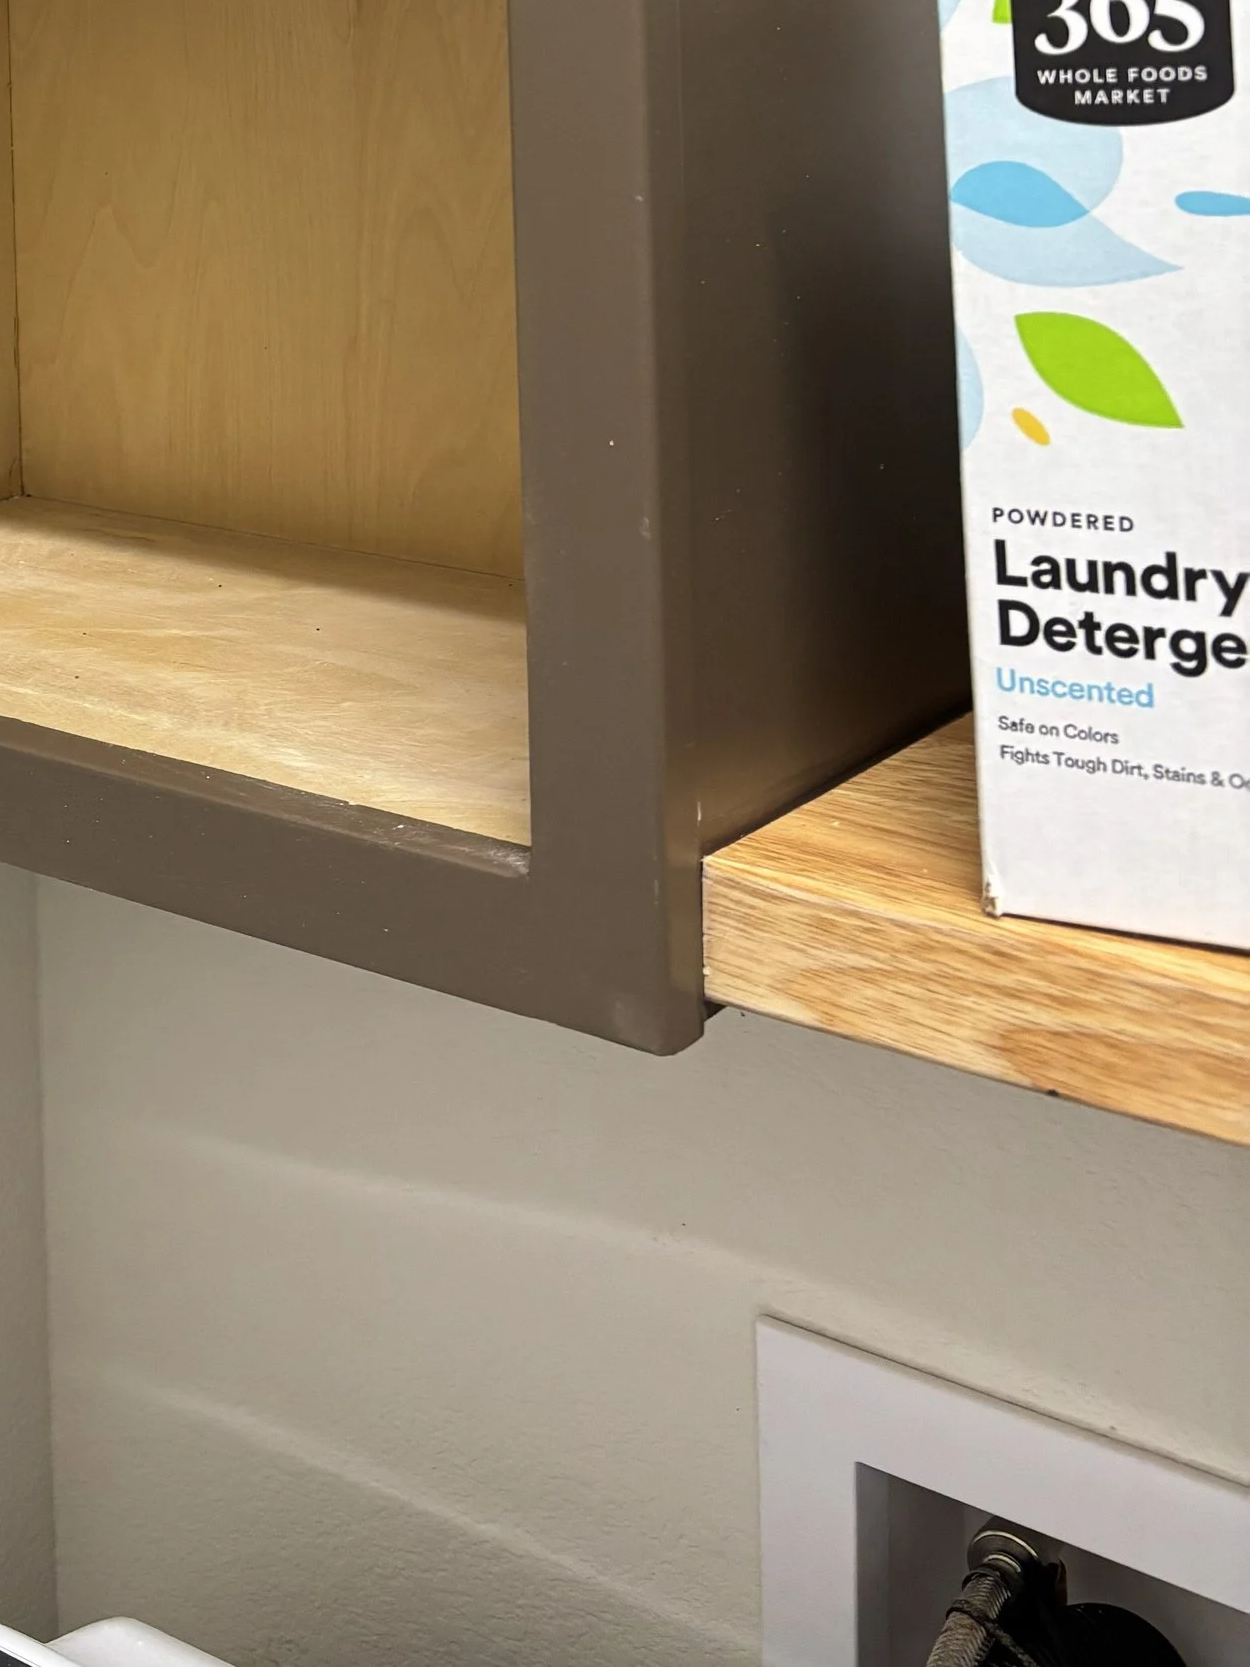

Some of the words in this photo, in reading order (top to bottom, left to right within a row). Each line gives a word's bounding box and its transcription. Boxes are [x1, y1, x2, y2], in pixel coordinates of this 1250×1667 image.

[1036, 68, 1118, 84] WHOLE
[1127, 66, 1208, 82] FOODS
[1074, 88, 1171, 105] MARKET
[992, 507, 1135, 533] POWDERED
[994, 538, 1250, 617] Laundry
[997, 598, 1248, 678] Deterge
[996, 667, 1155, 709] Unscented
[998, 715, 1035, 735] Safe
[1038, 725, 1060, 738] on
[1063, 723, 1120, 746] Colors
[1000, 745, 1051, 767] Fights
[1052, 751, 1108, 774] Tough
[1111, 759, 1150, 780] Dirt,
[1153, 763, 1207, 786] Stains
[1210, 770, 1226, 788] &
